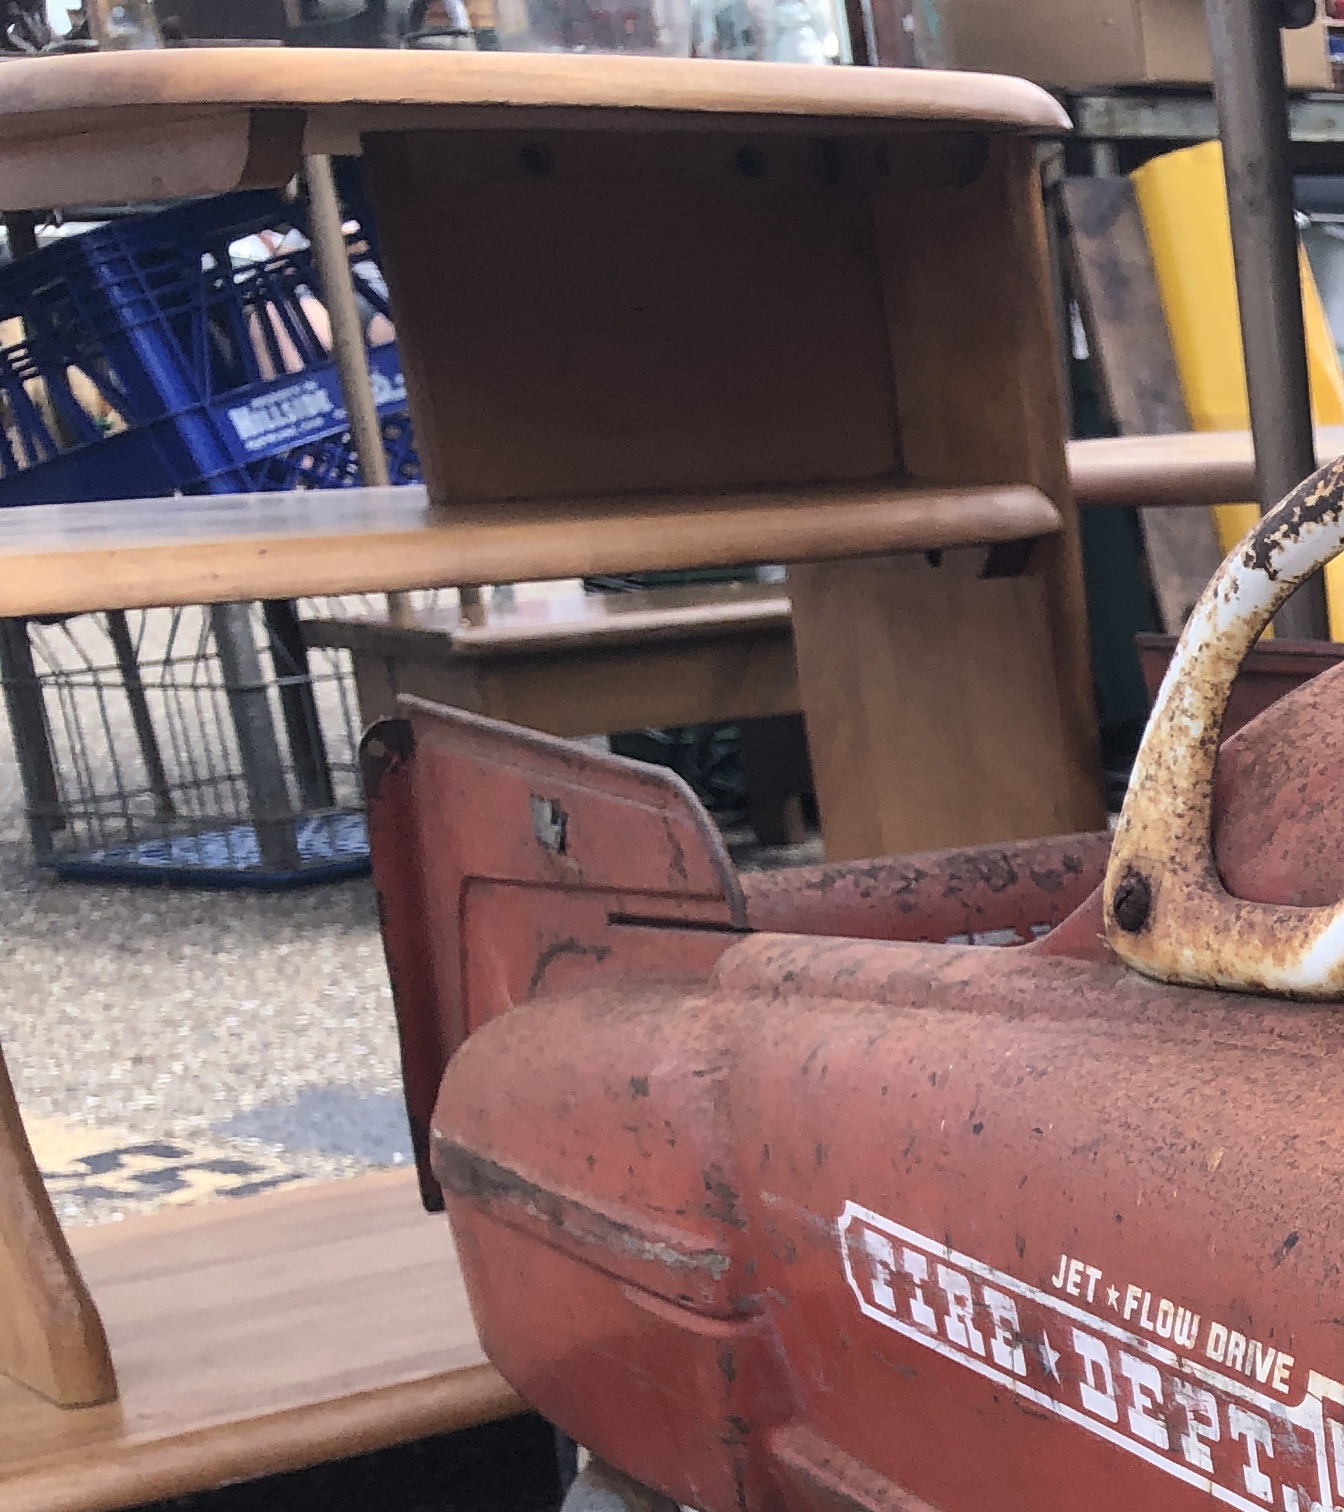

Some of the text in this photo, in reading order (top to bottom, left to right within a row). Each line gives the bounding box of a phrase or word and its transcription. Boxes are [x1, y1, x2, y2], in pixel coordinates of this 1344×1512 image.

[861, 1227, 1027, 1377] FIRE
[1051, 1254, 1295, 1395] JET FLOW DRIVE
